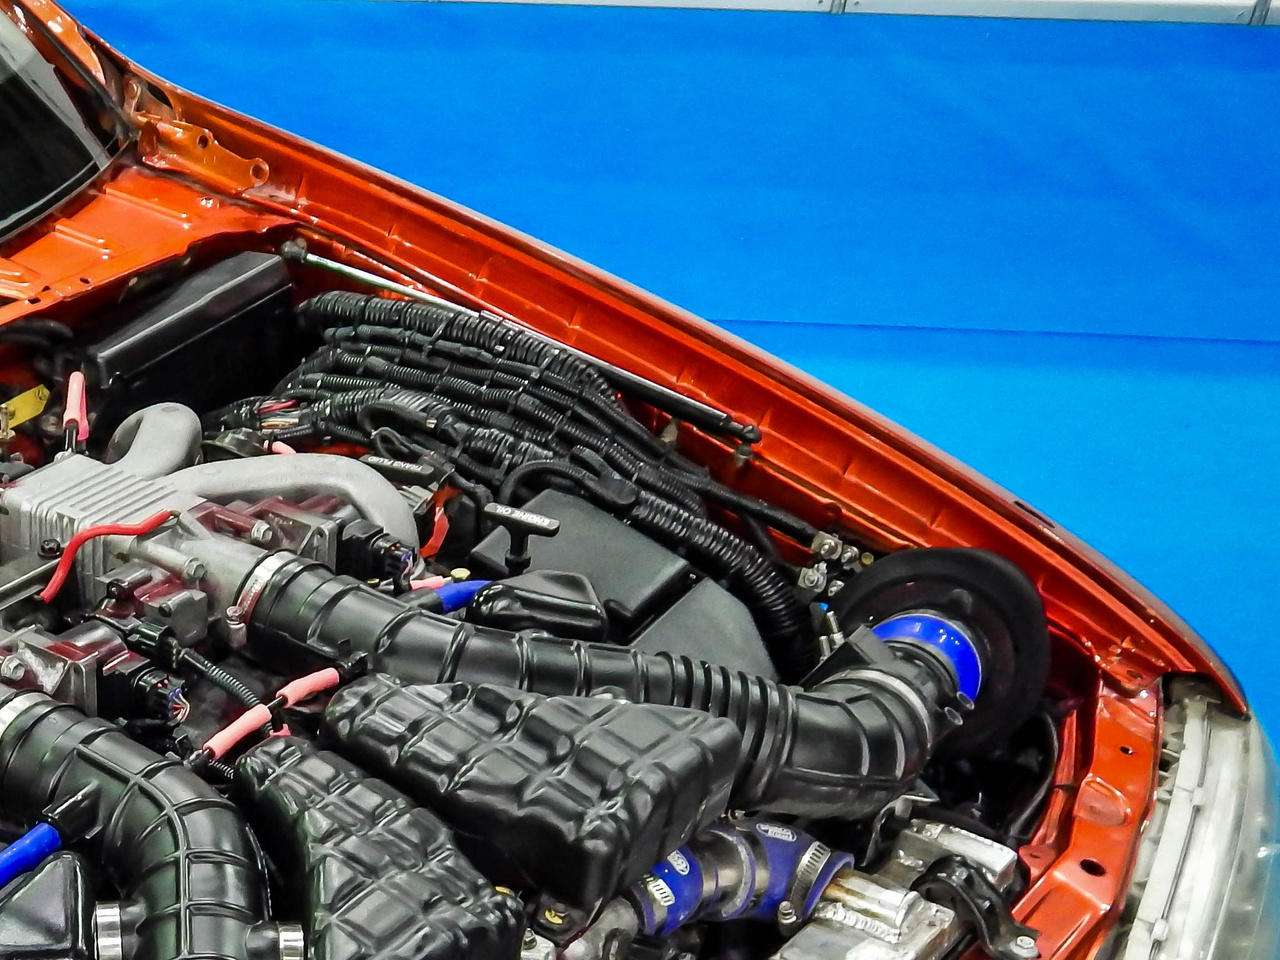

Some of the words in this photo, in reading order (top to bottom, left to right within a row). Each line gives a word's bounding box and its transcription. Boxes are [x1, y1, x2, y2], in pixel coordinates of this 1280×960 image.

[394, 459, 423, 473] TRANS
[496, 505, 511, 516] OIL
[514, 508, 551, 527] ENGINE
